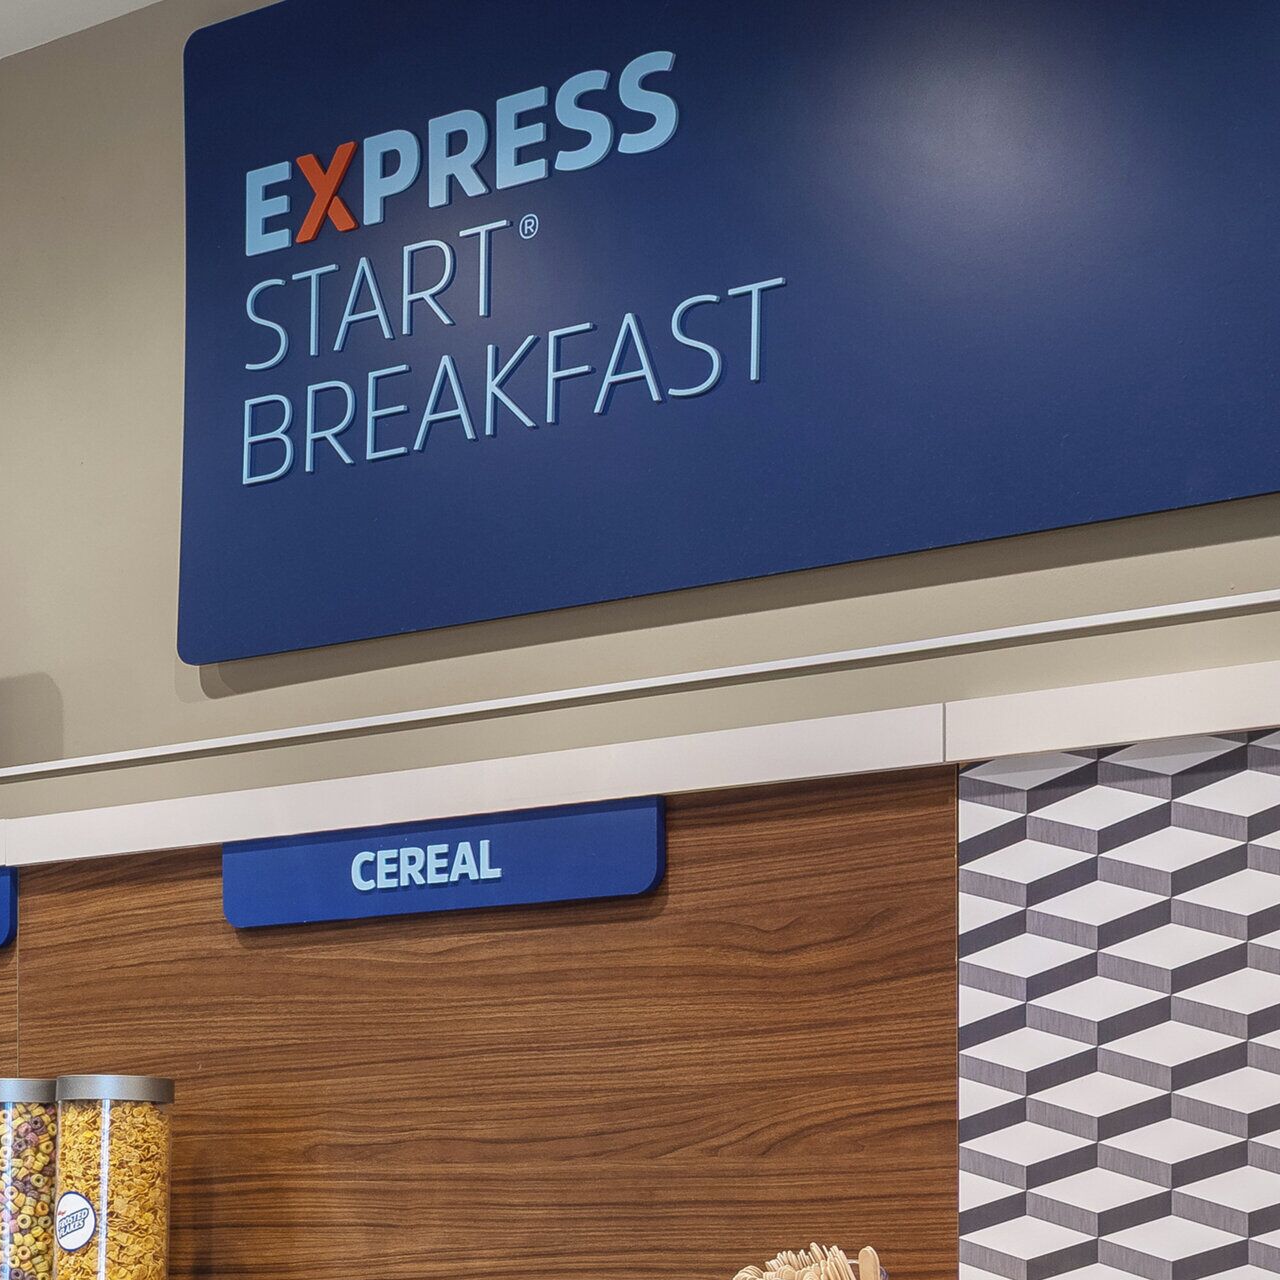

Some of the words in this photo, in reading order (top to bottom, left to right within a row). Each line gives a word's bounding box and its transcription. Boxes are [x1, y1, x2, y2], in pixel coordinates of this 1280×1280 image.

[245, 50, 680, 257] EXPRESS
[242, 276, 786, 486] BREAKFAST
[351, 839, 503, 892] CEREAL
